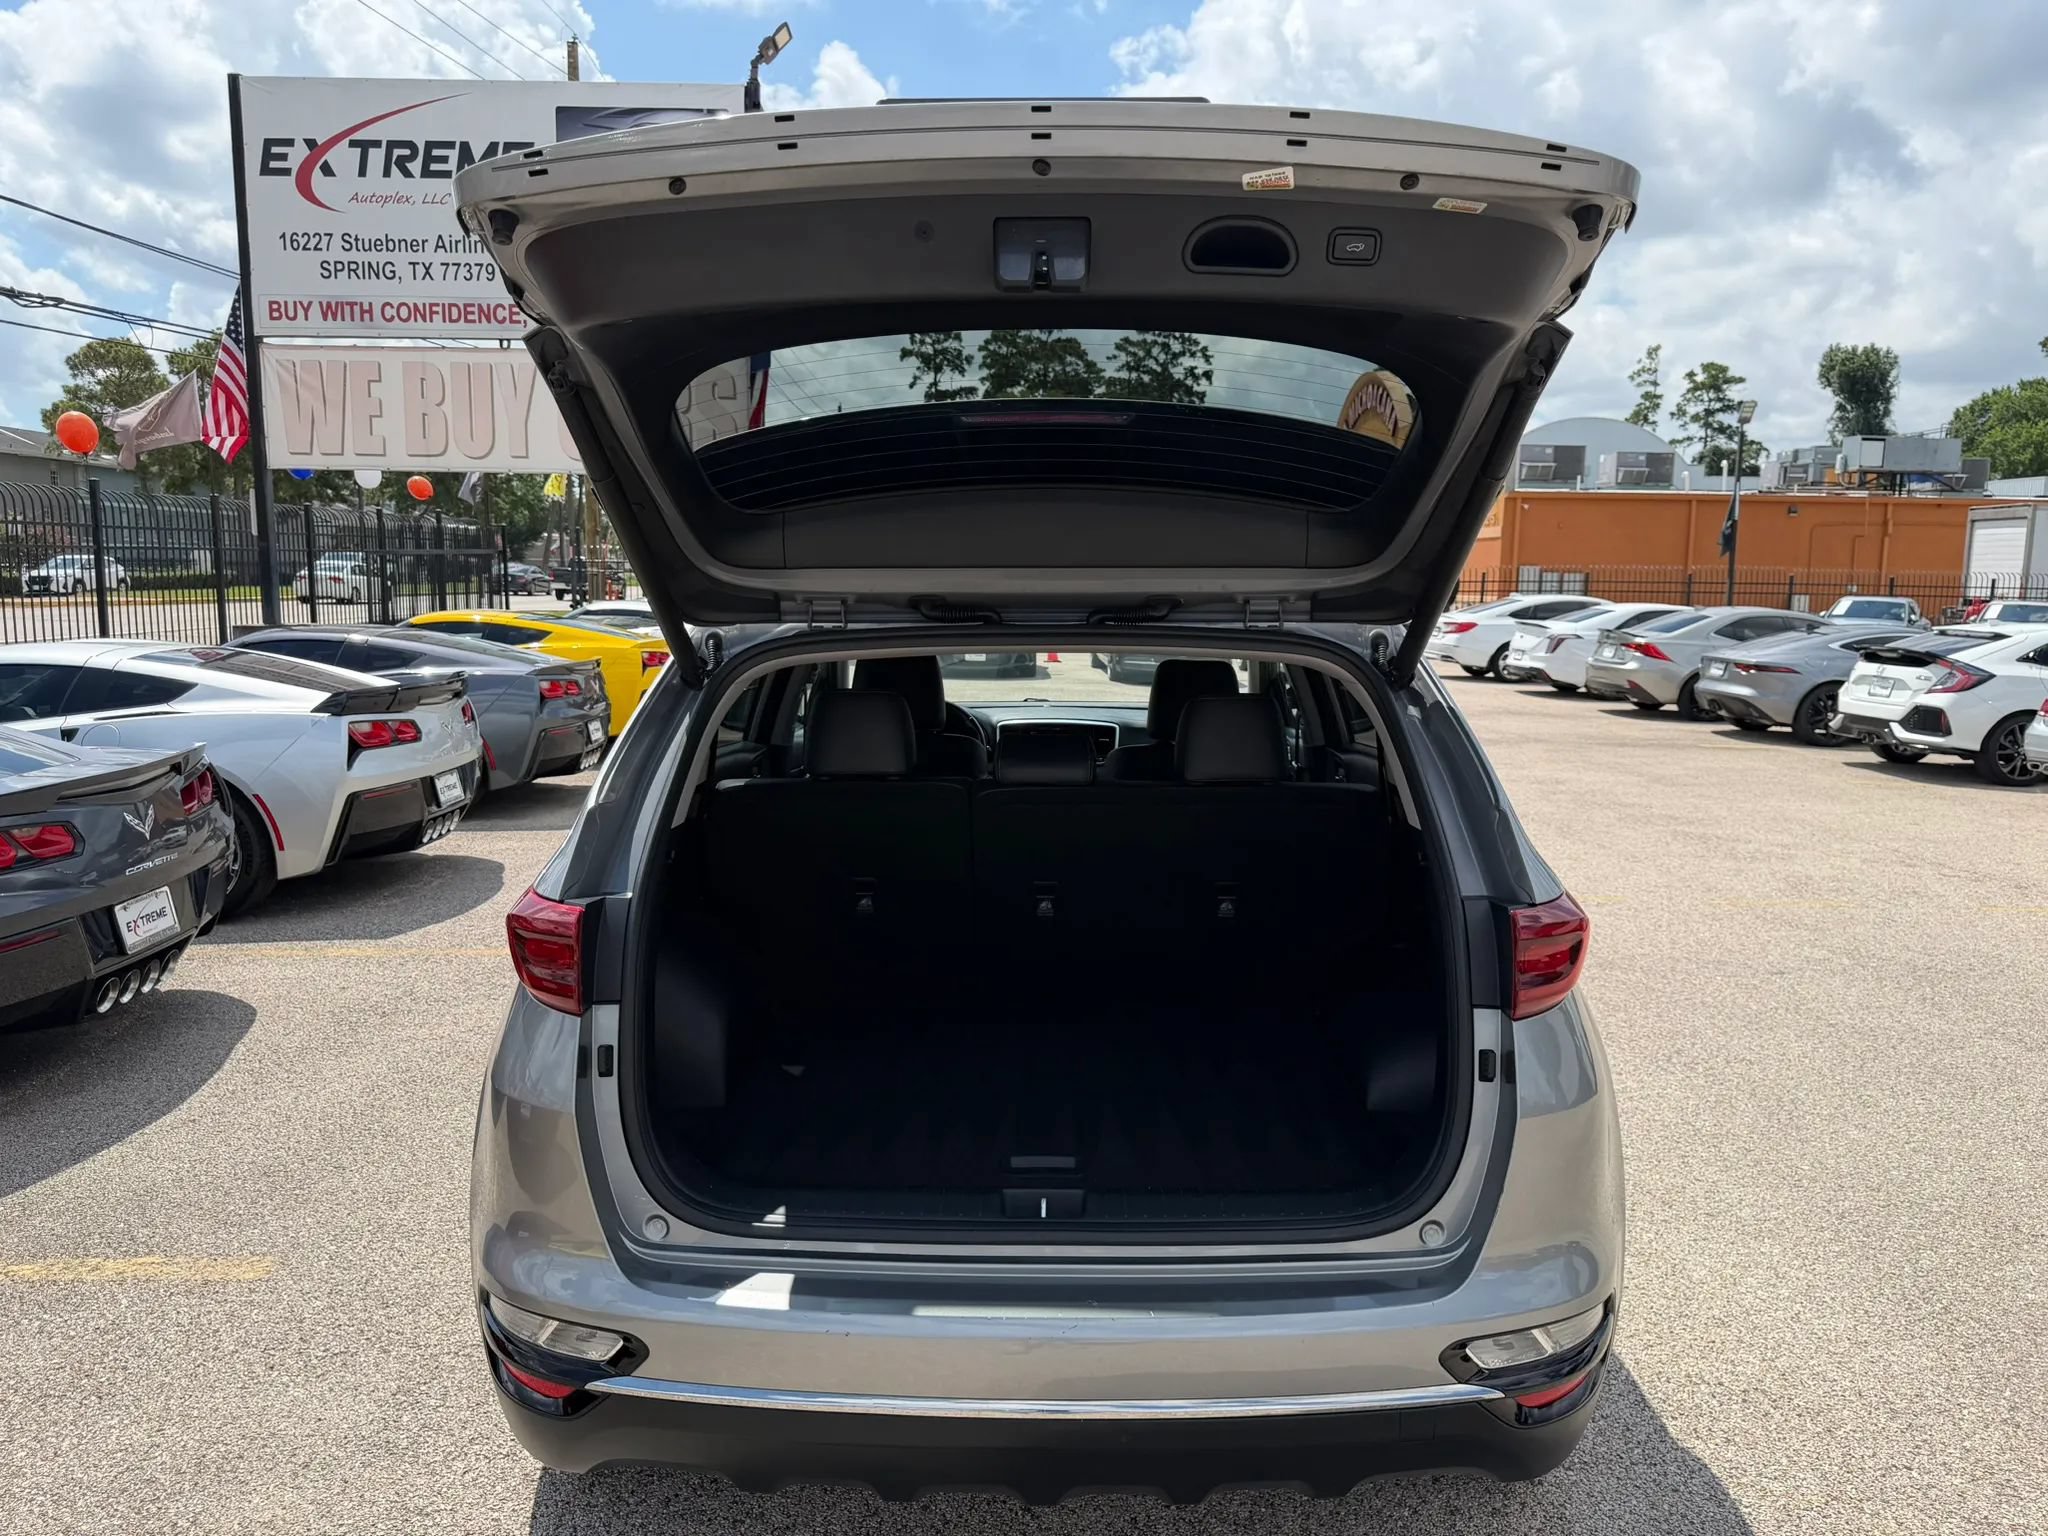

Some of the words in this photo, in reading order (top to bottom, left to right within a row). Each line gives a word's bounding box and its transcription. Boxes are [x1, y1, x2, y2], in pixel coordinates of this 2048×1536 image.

[348, 191, 415, 208] Autoplex,
[422, 192, 452, 205] LLC
[278, 232, 334, 252] 16227
[340, 233, 428, 253] Stuebner
[434, 234, 485, 254] Airlin
[320, 260, 402, 284] SPRING,
[408, 262, 434, 281] TX
[440, 261, 495, 281] 77379
[268, 300, 313, 321] BUY
[319, 301, 374, 323] WITH
[380, 302, 528, 328] CONFIDENCE,
[276, 359, 386, 457] WE
[402, 360, 537, 460] BUY
[125, 853, 178, 875] CORVETTE
[126, 906, 168, 933] EXTREME
